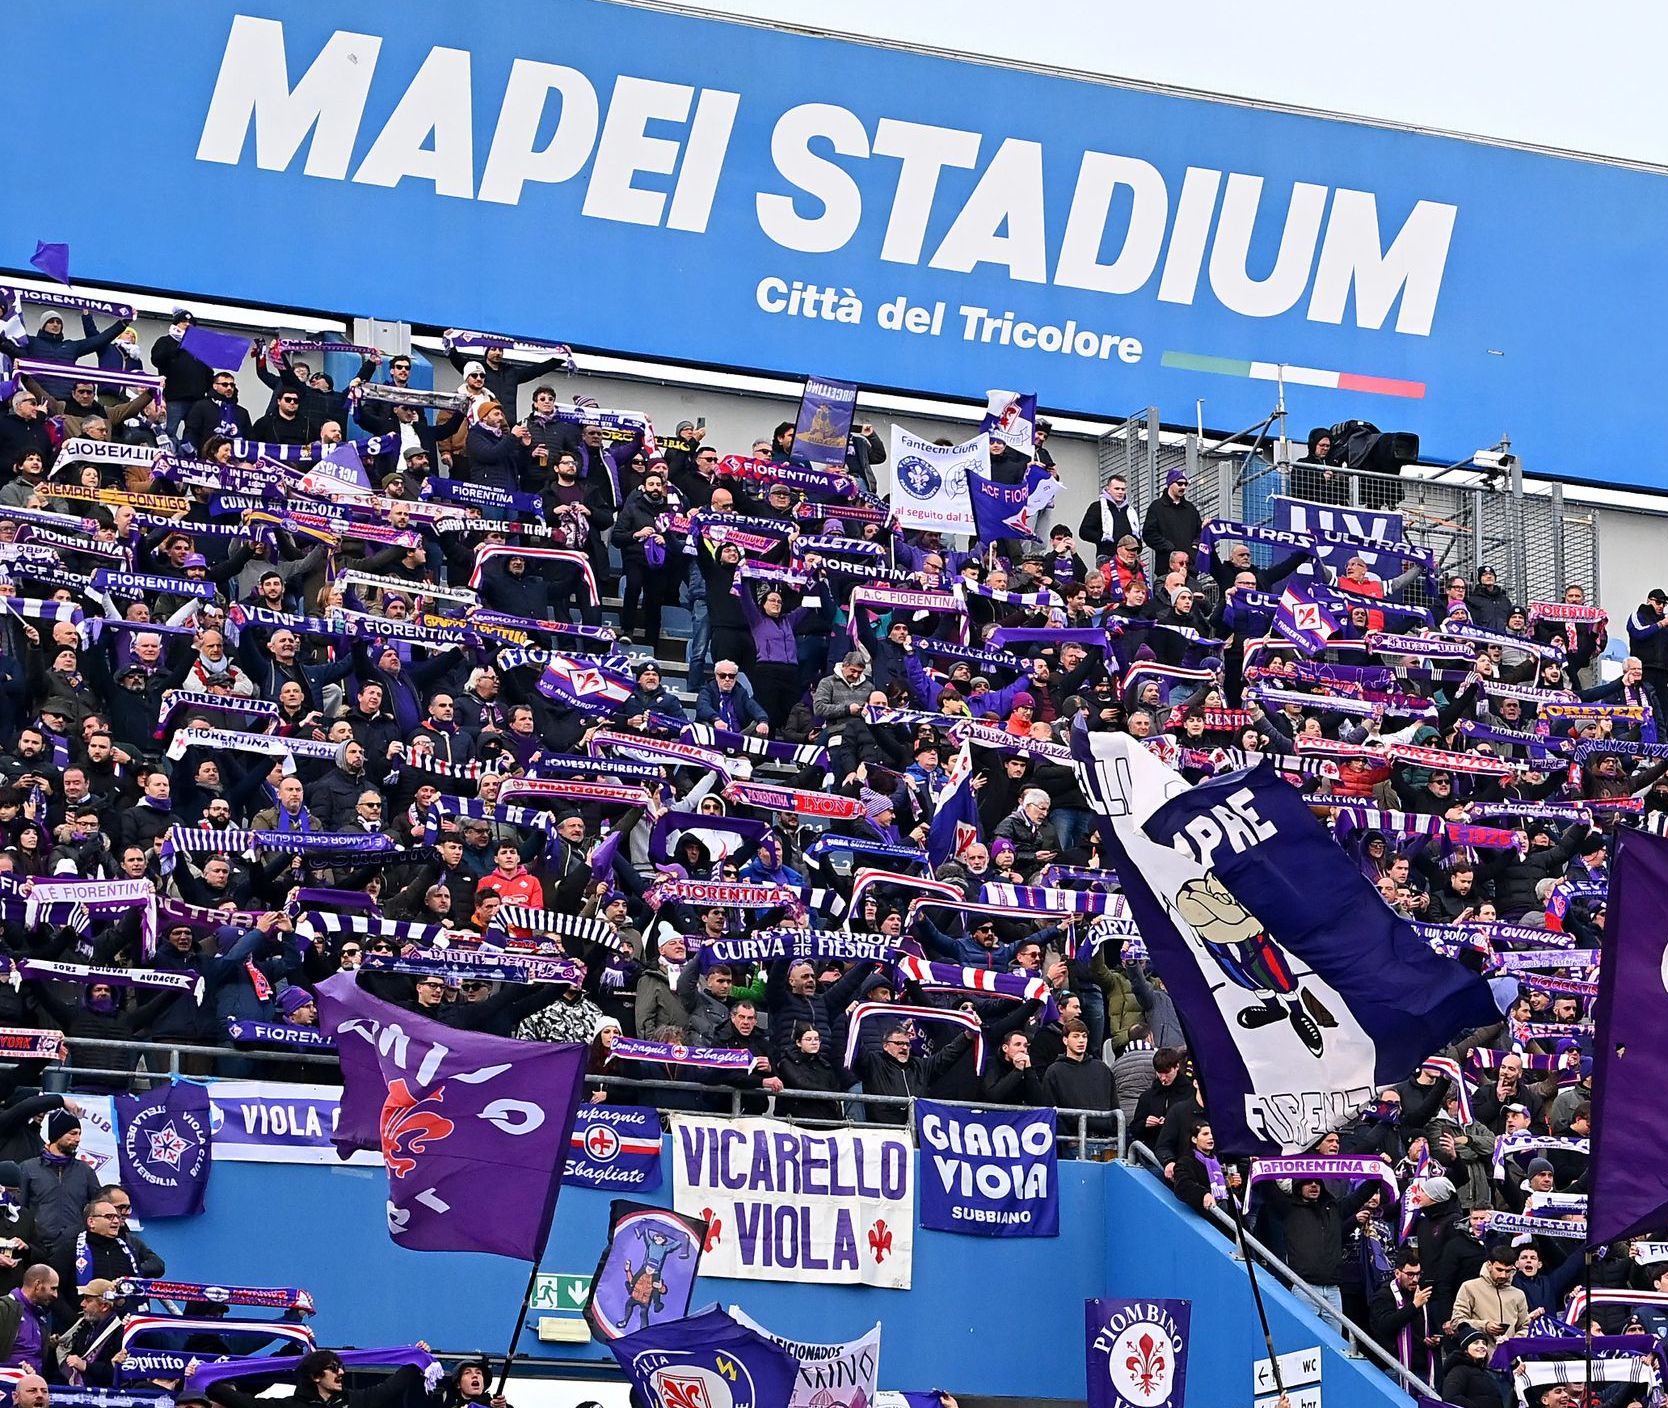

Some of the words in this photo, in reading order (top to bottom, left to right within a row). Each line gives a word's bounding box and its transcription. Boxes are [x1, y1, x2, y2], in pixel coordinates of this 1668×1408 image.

[195, 14, 740, 233] MAPEI
[756, 103, 1458, 337] STADIUM
[17, 291, 113, 313] FIORENTINA
[756, 277, 863, 325] Città
[877, 292, 944, 336] del
[956, 303, 1142, 362] Tricolore
[168, 457, 179, 466] DI
[181, 459, 220, 474] BABBO
[229, 468, 241, 479] IN
[243, 470, 278, 484] FIGLIO
[743, 459, 829, 485] FIORENTINA
[452, 485, 513, 504] FIORENTINA
[220, 496, 263, 511] CURVA
[286, 499, 345, 518] FIESOLE
[136, 512, 252, 536] FIORENTINA
[1209, 523, 1317, 549] ULTRAS
[1323, 531, 1430, 562] ULTRAS
[107, 571, 206, 595] FIORENTINA
[364, 621, 465, 641] FIORENTINA
[187, 728, 270, 750] FIORENTINA
[621, 735, 701, 756] FIORENTINA
[1489, 726, 1545, 745] FIORENTINA
[802, 797, 846, 817] LYON
[677, 885, 783, 903] FIORENTINA
[240, 1103, 323, 1137] VIOLA
[922, 1113, 1054, 1156] GIANO
[677, 1124, 908, 1200] VICARELLO
[933, 1153, 1049, 1200] VIOLA
[951, 1205, 1031, 1224] SUBBIANO
[733, 1201, 859, 1270] VIOLA
[1092, 1302, 1184, 1355] PIOMBINO
[1301, 1355, 1318, 1373] WC
